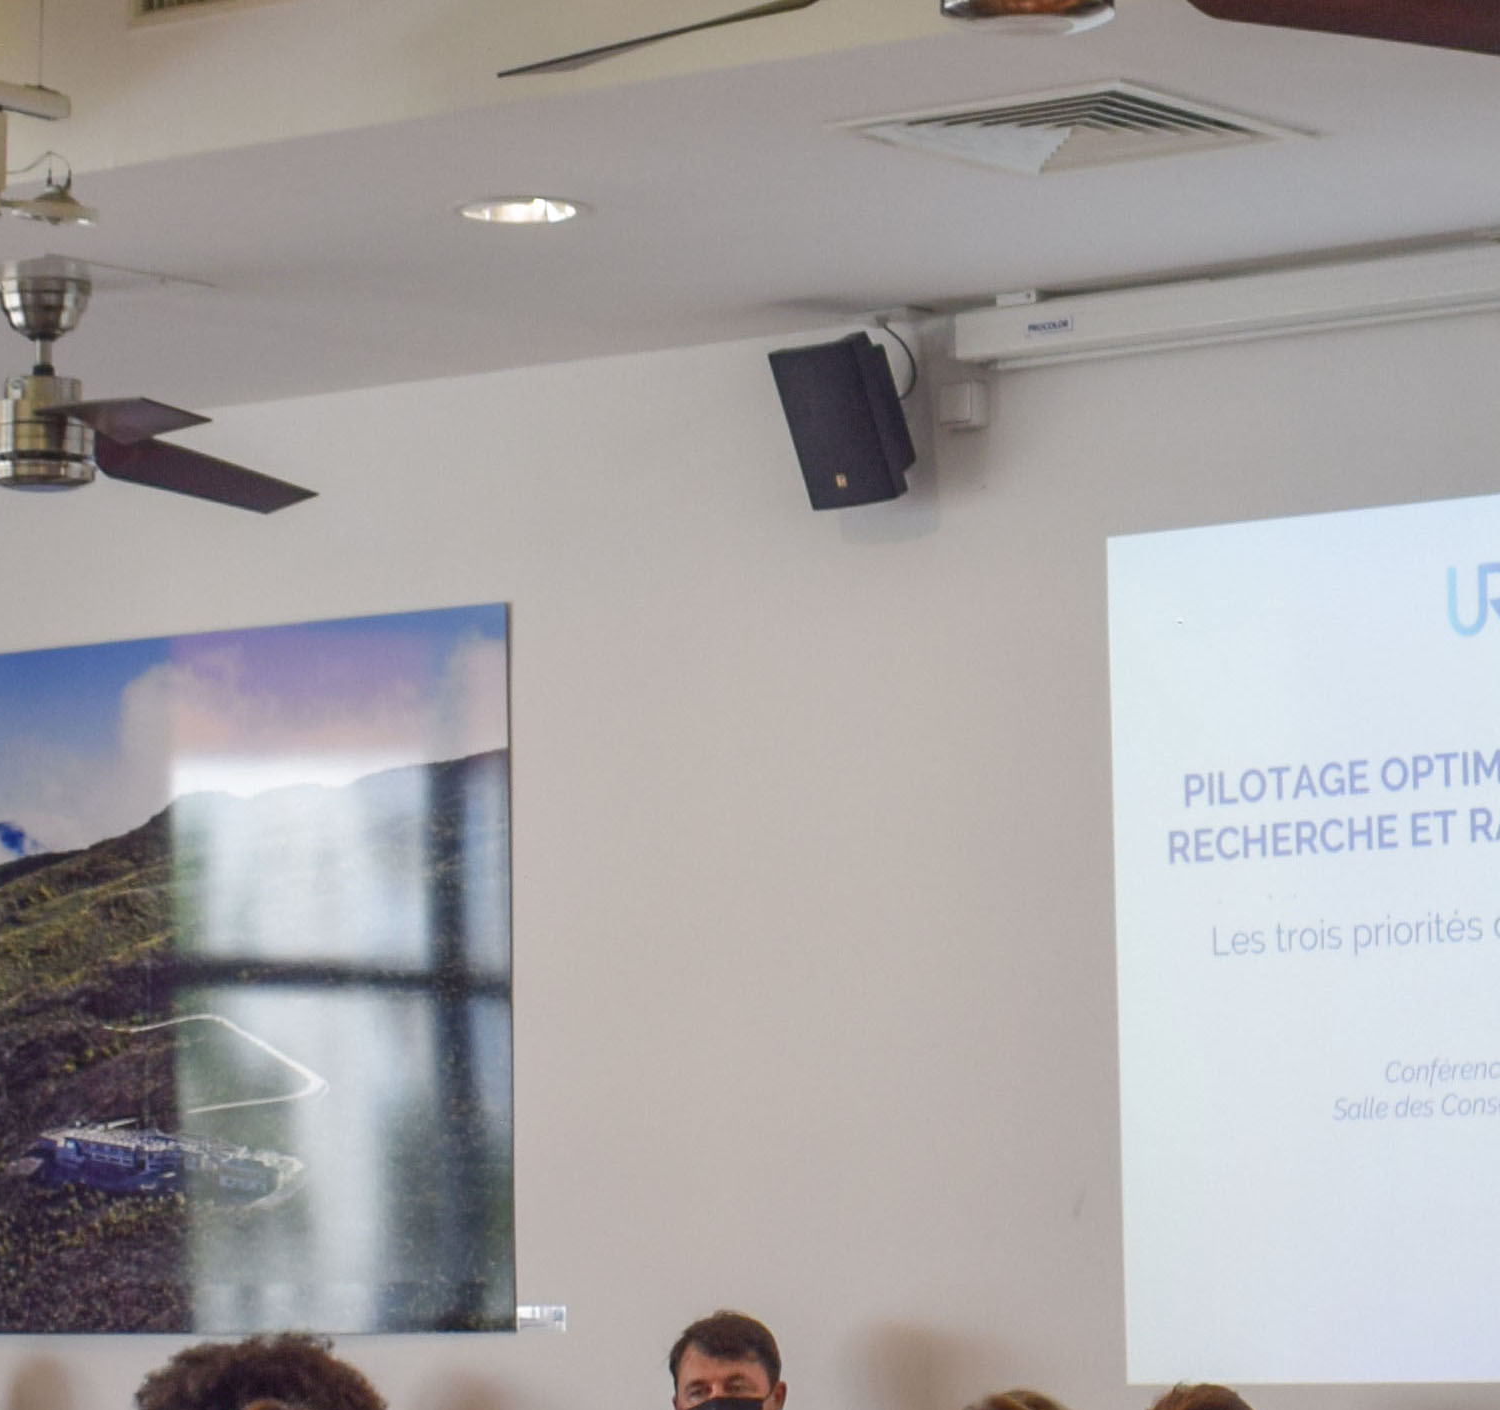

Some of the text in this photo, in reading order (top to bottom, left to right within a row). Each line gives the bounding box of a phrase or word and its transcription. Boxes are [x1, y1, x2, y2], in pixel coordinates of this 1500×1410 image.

[1183, 758, 1370, 809] PILOTAGE
[1167, 813, 1399, 865] RECHERCHE
[1409, 808, 1458, 849] ET
[1212, 927, 1266, 957] Les
[1275, 923, 1343, 953] trois
[1353, 910, 1484, 956] priorités
[1334, 1097, 1388, 1121] Salle
[1393, 1096, 1434, 1119] des
